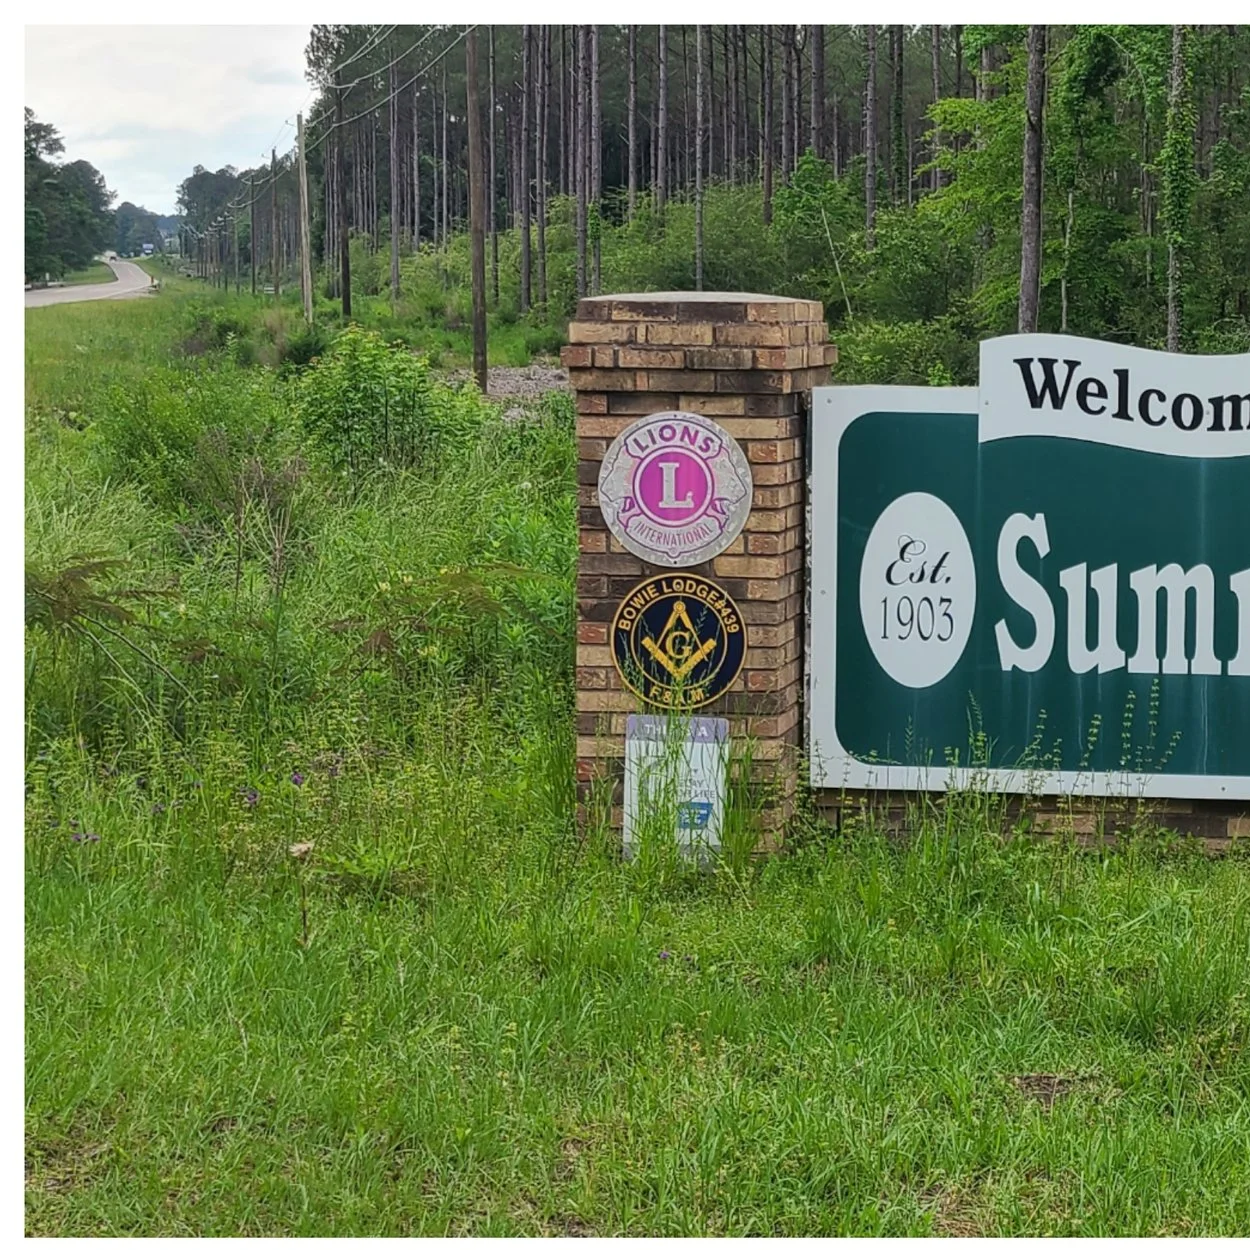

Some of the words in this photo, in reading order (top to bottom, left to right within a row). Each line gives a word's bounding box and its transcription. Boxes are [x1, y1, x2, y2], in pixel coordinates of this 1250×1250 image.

[633, 424, 715, 453] LIONS
[658, 462, 694, 509] L
[634, 521, 713, 547] INTERNATIONAL
[885, 534, 951, 585] Est.
[618, 585, 659, 632] BOWIE
[662, 579, 740, 633] LODGE#439
[880, 596, 955, 642] 1903
[666, 631, 692, 659] G
